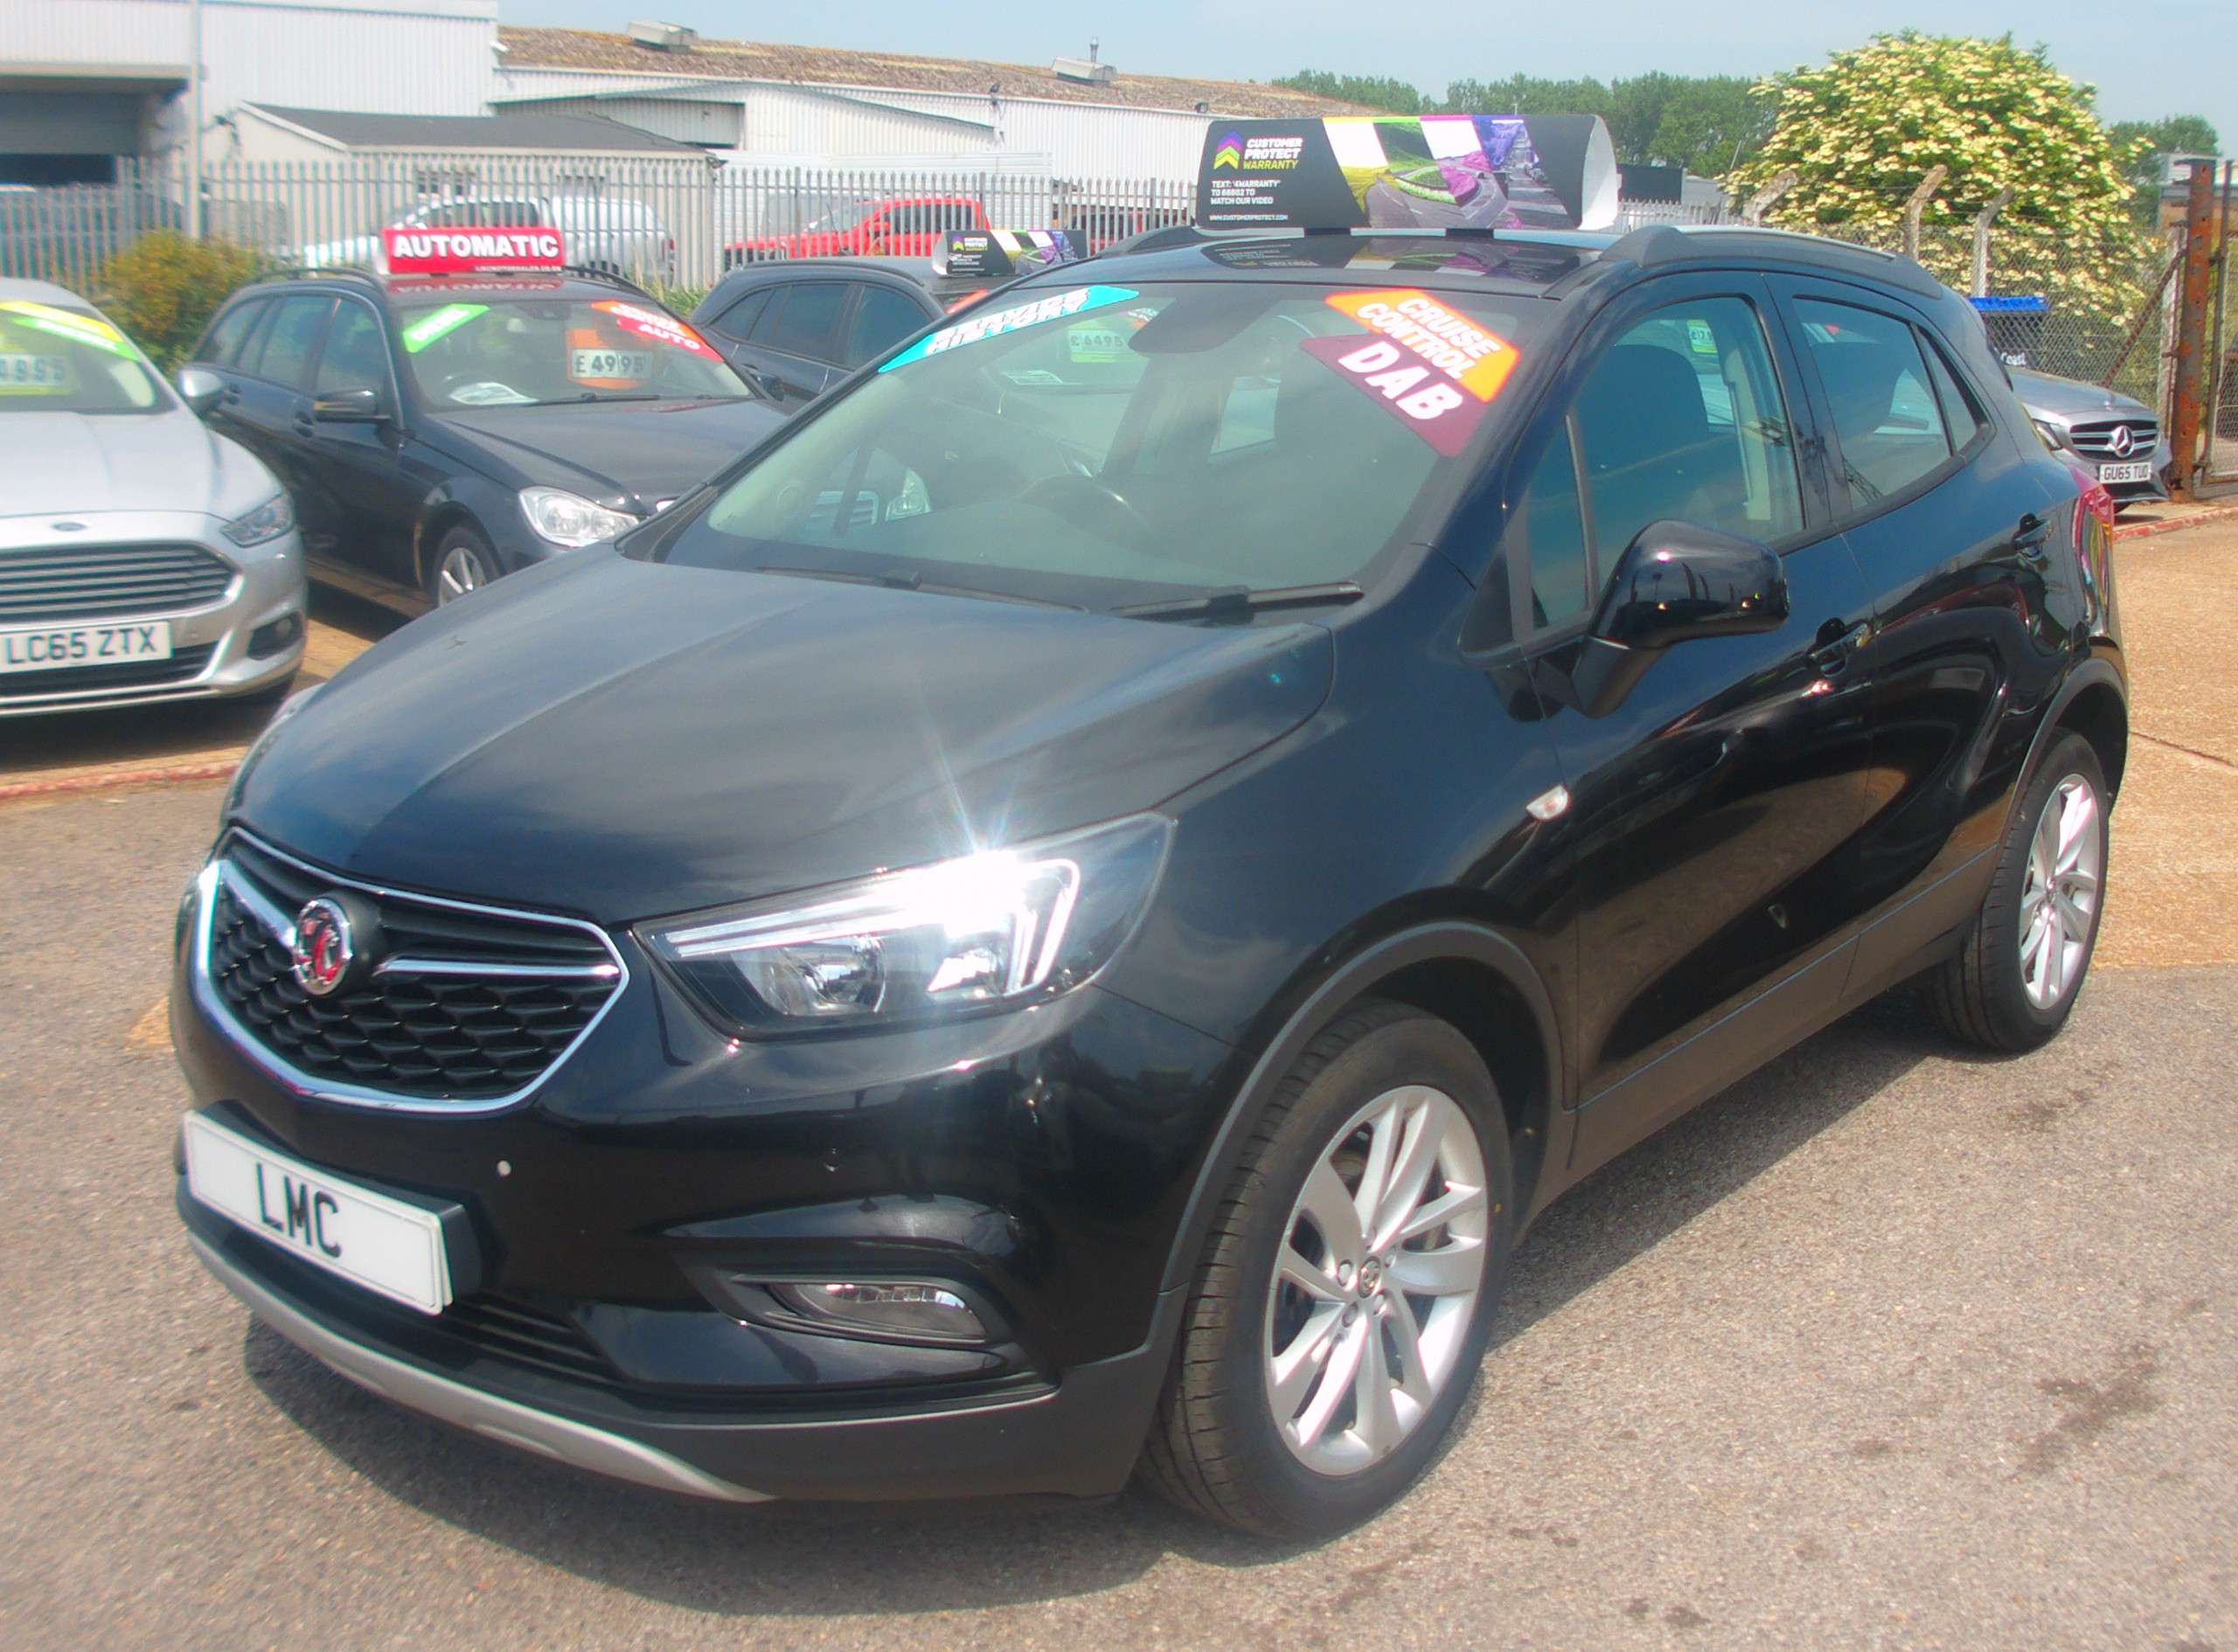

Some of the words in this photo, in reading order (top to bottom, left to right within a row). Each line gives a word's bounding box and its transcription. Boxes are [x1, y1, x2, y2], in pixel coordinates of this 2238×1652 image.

[1244, 149, 1301, 159] PROTECT
[1247, 138, 1303, 148] CUSTOMER
[1243, 160, 1298, 170] WARRANTY
[393, 234, 560, 258] AUTOMATIC
[638, 323, 700, 350] AUTO
[1357, 302, 1477, 379] CONTROL
[1397, 298, 1502, 359] CRUISE
[1338, 341, 1463, 420] DAB
[2104, 467, 2130, 480] GU65
[5, 632, 88, 664] LC65
[97, 626, 156, 656] ZTX
[256, 1162, 342, 1259] LMC
